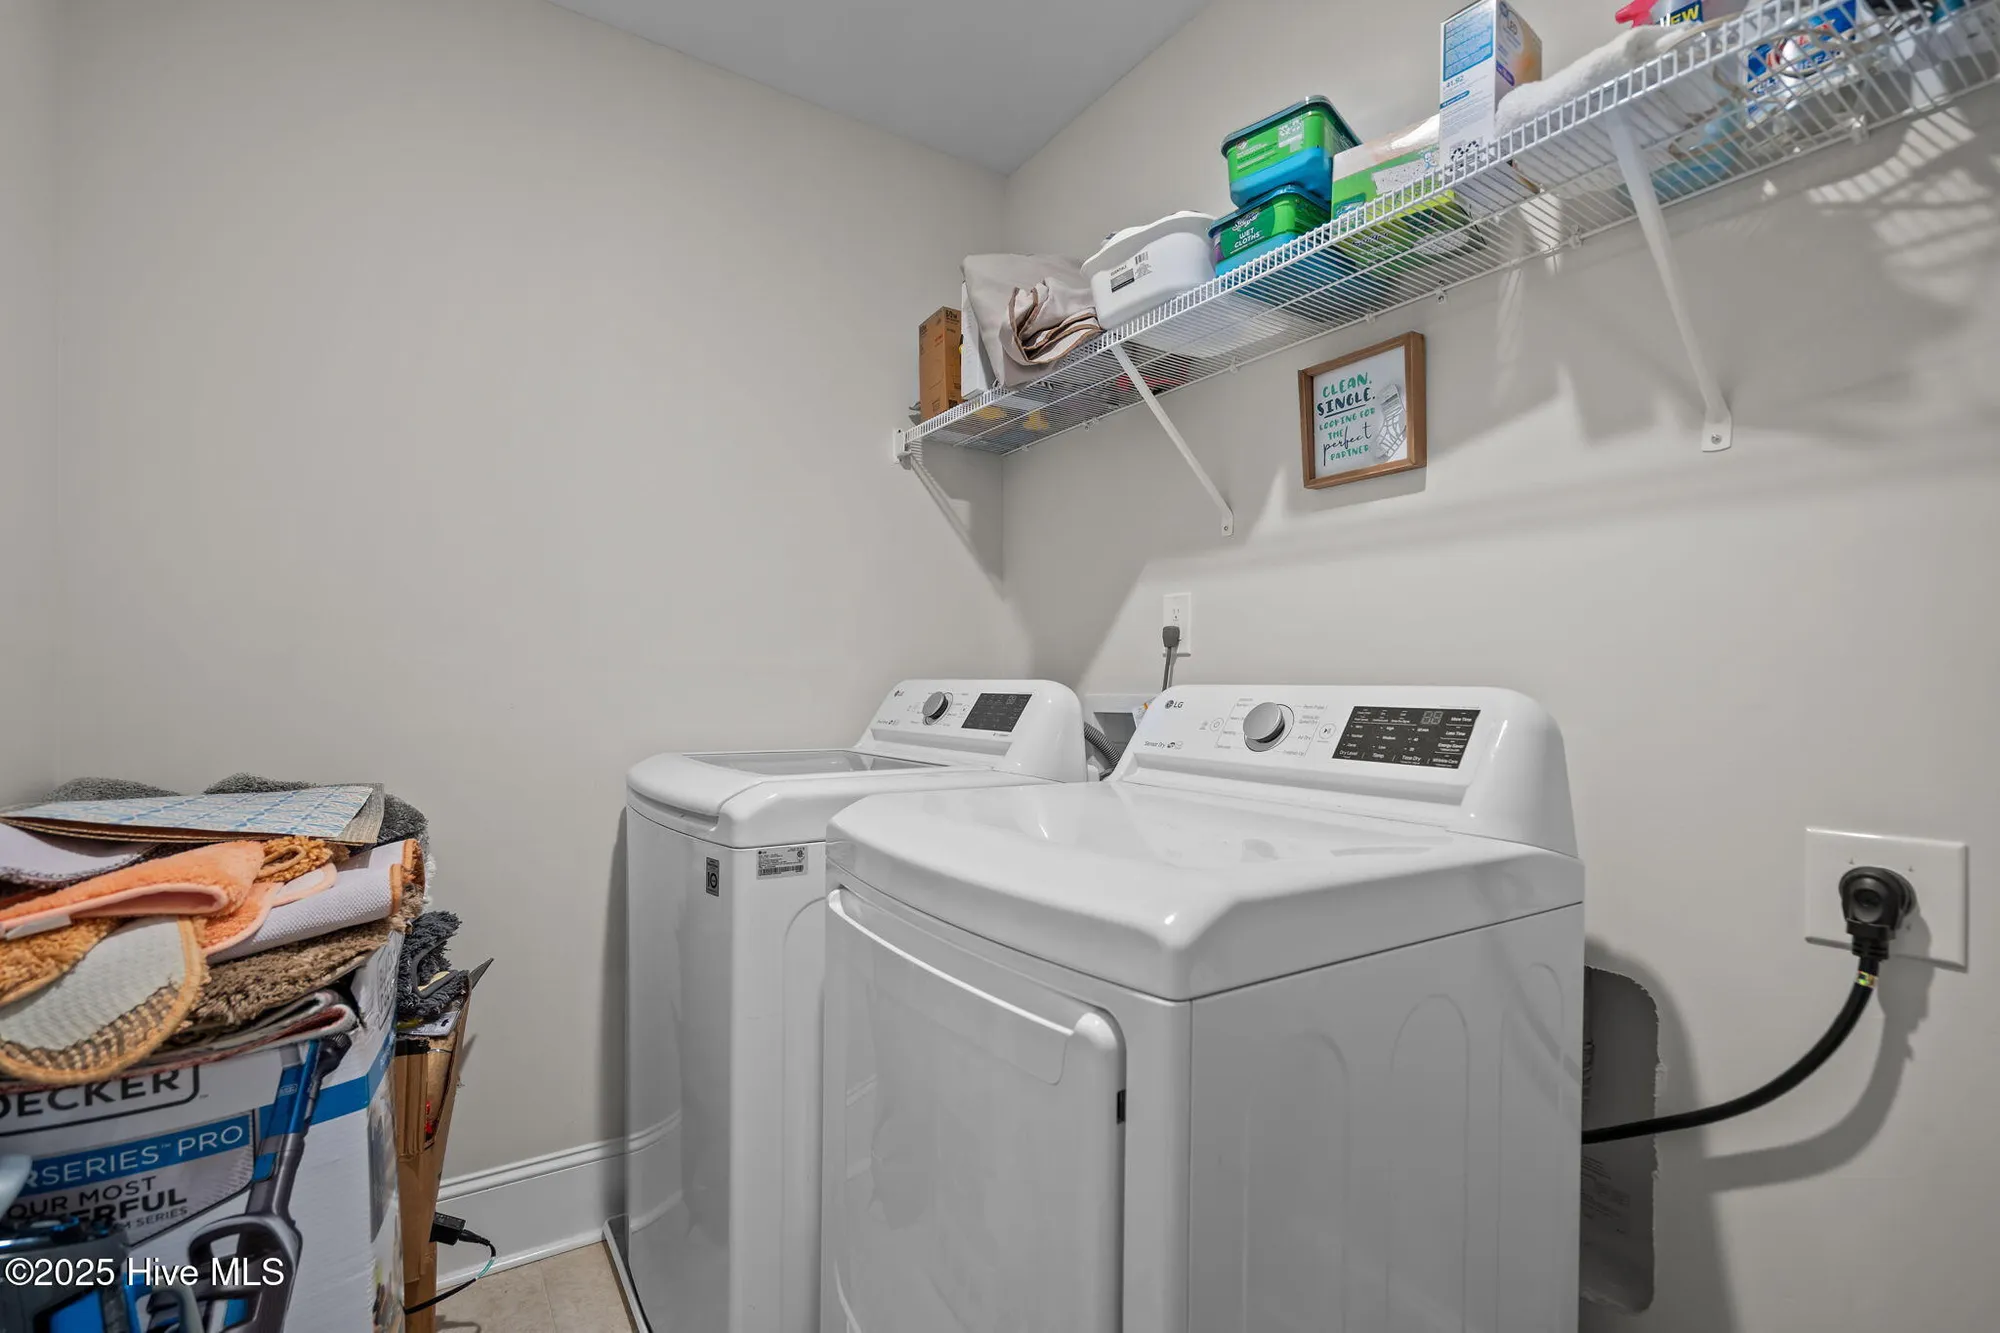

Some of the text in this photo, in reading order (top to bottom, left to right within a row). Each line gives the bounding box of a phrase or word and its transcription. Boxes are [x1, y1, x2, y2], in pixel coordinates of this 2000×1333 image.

[1234, 231, 1260, 248] CLOTHS
[1239, 227, 1255, 239] WET
[1322, 372, 1372, 398] CLEAN.
[1316, 387, 1376, 416] SINGLE.
[1319, 407, 1376, 431] LOOKING FOR
[1323, 422, 1372, 466] perfect
[1328, 429, 1343, 440] THE
[1330, 444, 1369, 461] PARTNER
[177, 1125, 243, 1157] PRO
[8, 1176, 157, 1220] OUR MOST
[135, 1206, 188, 1228] SERIES
